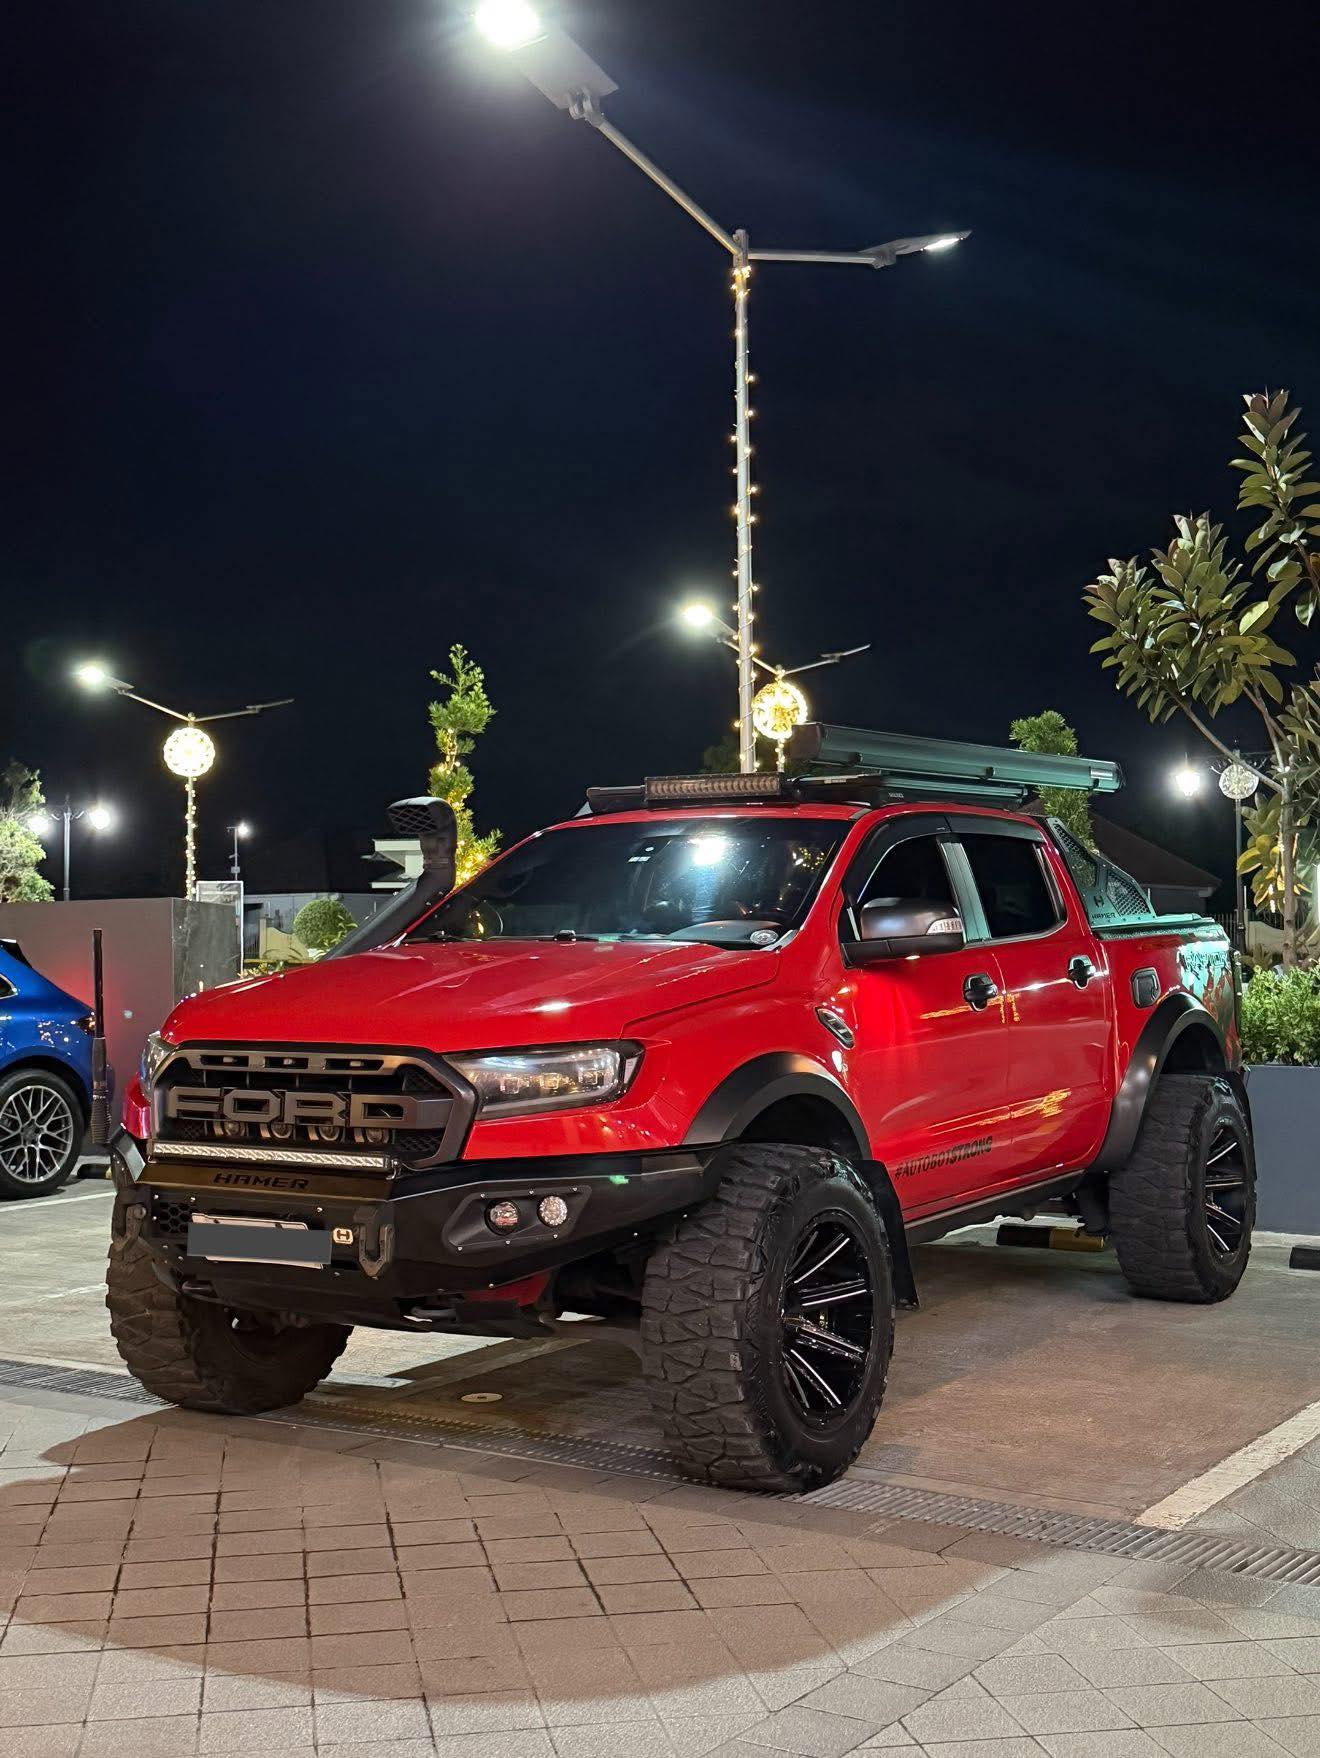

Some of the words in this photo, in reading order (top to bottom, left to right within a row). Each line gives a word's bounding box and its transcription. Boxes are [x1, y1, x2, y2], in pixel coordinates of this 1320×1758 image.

[167, 1086, 417, 1128] FORD
[894, 1136, 993, 1179] #AUTOBOTSTRONG
[213, 1172, 310, 1190] HAMER
